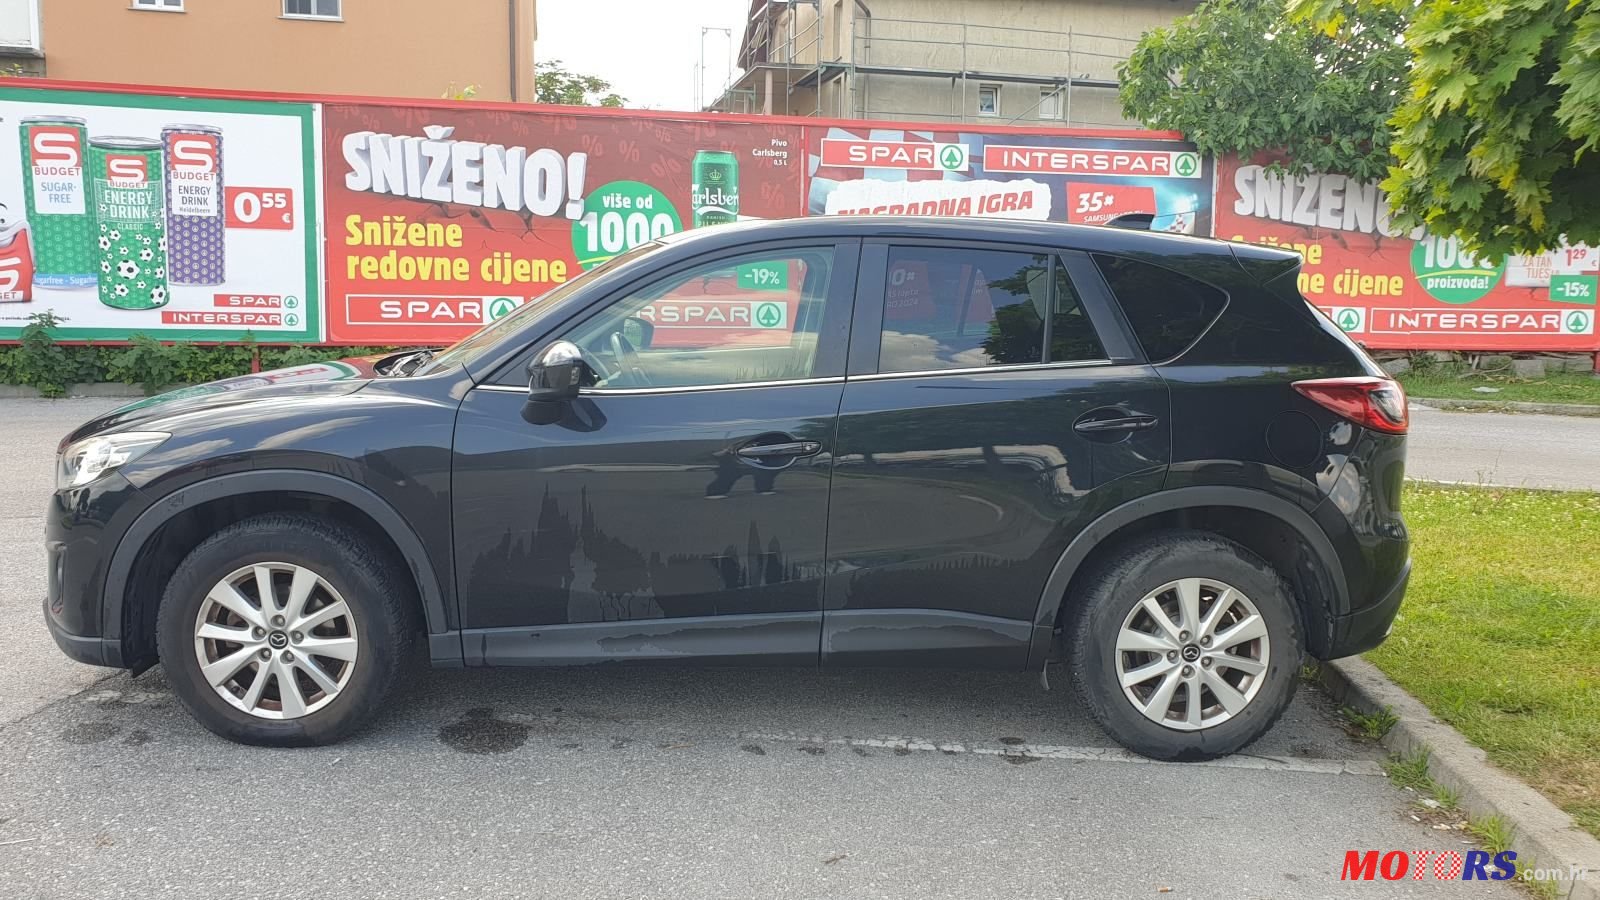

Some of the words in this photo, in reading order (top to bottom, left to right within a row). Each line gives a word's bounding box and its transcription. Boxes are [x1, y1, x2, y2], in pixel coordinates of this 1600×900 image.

[771, 139, 787, 147] Pivo
[752, 148, 787, 159] Carlsberg
[849, 146, 933, 164] SPAR
[1002, 150, 1169, 173] INTERSPAR
[34, 167, 80, 176] BUDGET
[173, 171, 215, 181] BUDGET
[342, 125, 587, 220] SNIŽENO!
[104, 190, 152, 205] ENERGY
[178, 185, 211, 196] ENERGY
[49, 193, 72, 204] FREE
[181, 196, 209, 206] DRINK
[602, 193, 632, 209] više
[635, 194, 653, 209] od
[977, 191, 1033, 214] IGRA
[110, 205, 150, 219] DRINK
[345, 214, 463, 247] Snižene
[347, 250, 470, 282] redovne
[480, 252, 568, 285] cijene
[744, 268, 780, 285] -19%
[1333, 269, 1404, 298] cijene
[1427, 276, 1489, 290] proizvoda!
[1556, 281, 1590, 298] -15%
[229, 296, 280, 306] SPAR
[380, 300, 481, 319] SPAR
[173, 313, 281, 324] INTERSPAR
[1390, 313, 1560, 329] INTERSPAR
